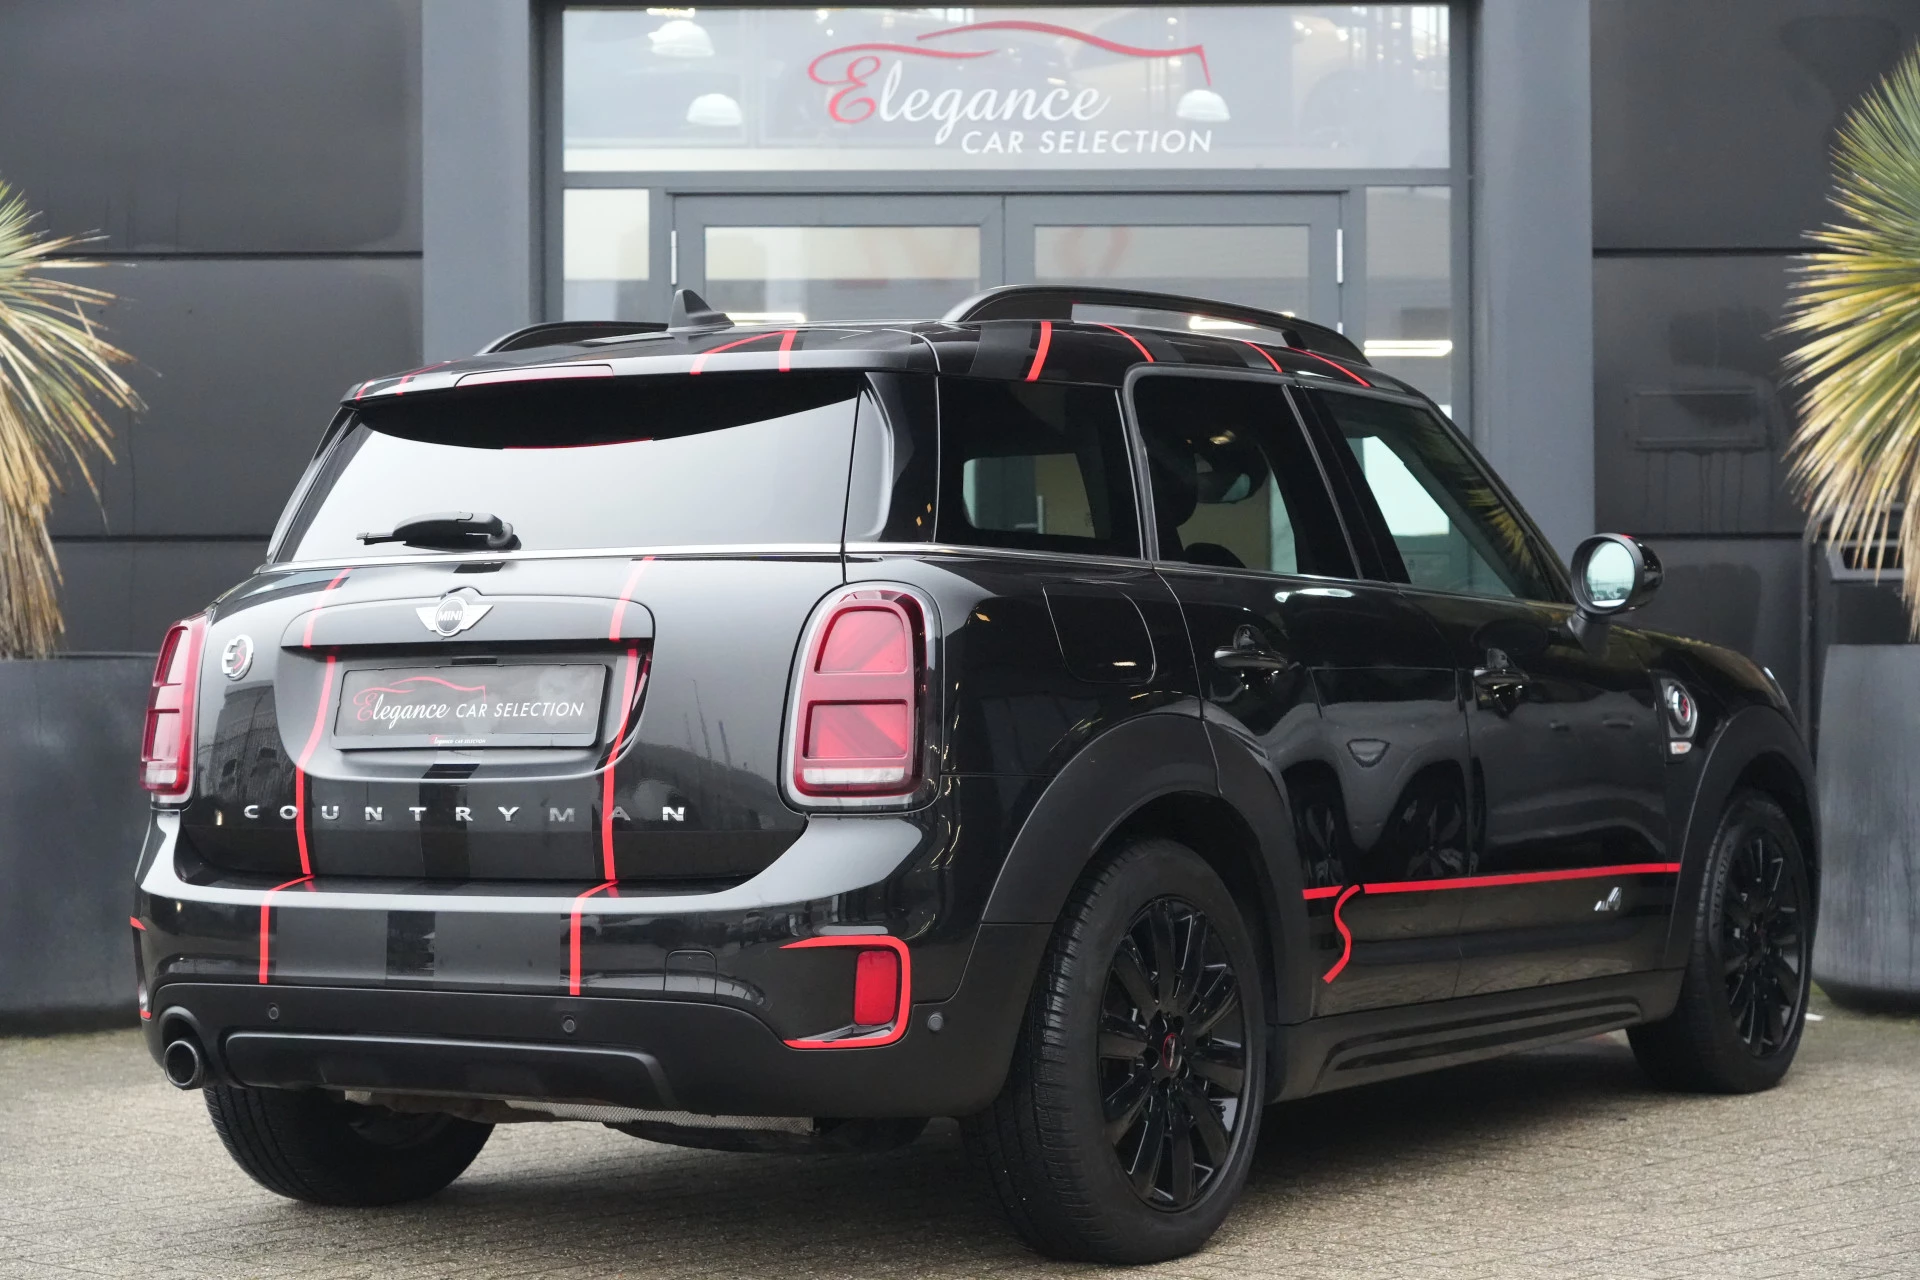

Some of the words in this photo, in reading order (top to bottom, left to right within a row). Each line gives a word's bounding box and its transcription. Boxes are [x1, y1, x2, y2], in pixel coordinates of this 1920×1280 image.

[808, 44, 1112, 146] Elegance
[961, 131, 1024, 154] CAR
[1038, 129, 1213, 154] SELECTION
[438, 610, 463, 621] MINI
[353, 687, 450, 730] Elegance
[455, 702, 487, 718] CAR
[493, 701, 585, 718] SELECTION
[243, 804, 685, 822] COUNTRYMAN
